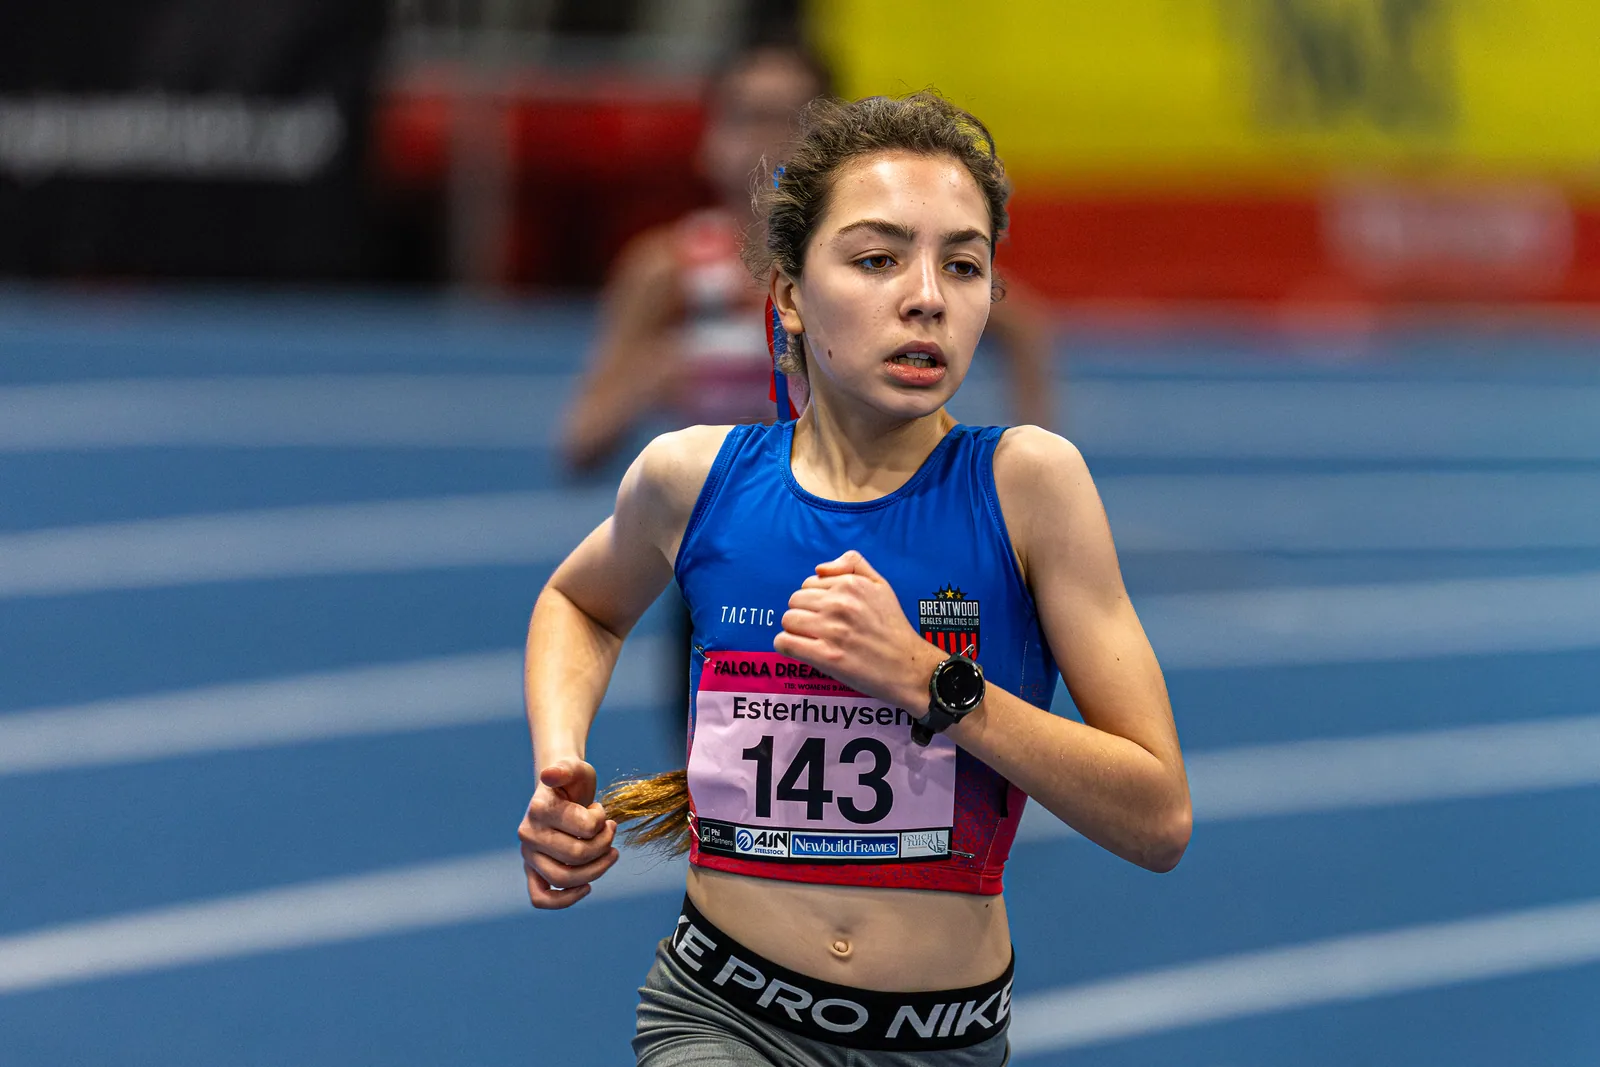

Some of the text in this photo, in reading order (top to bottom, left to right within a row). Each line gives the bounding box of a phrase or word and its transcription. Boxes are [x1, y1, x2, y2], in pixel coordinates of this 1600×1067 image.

[721, 606, 775, 626] TACTIC
[920, 601, 979, 616] BRENTWOOD
[920, 617, 979, 626] BEAGLES ATHLETICS CLUB
[714, 661, 834, 680] FALOLA DREA
[733, 697, 912, 729] Esterhuysen
[742, 735, 894, 825] 143
[711, 828, 721, 837] Phi
[711, 836, 734, 847] Partners
[754, 848, 784, 856] STEELSTOCK
[712, 955, 869, 1033] PRO
